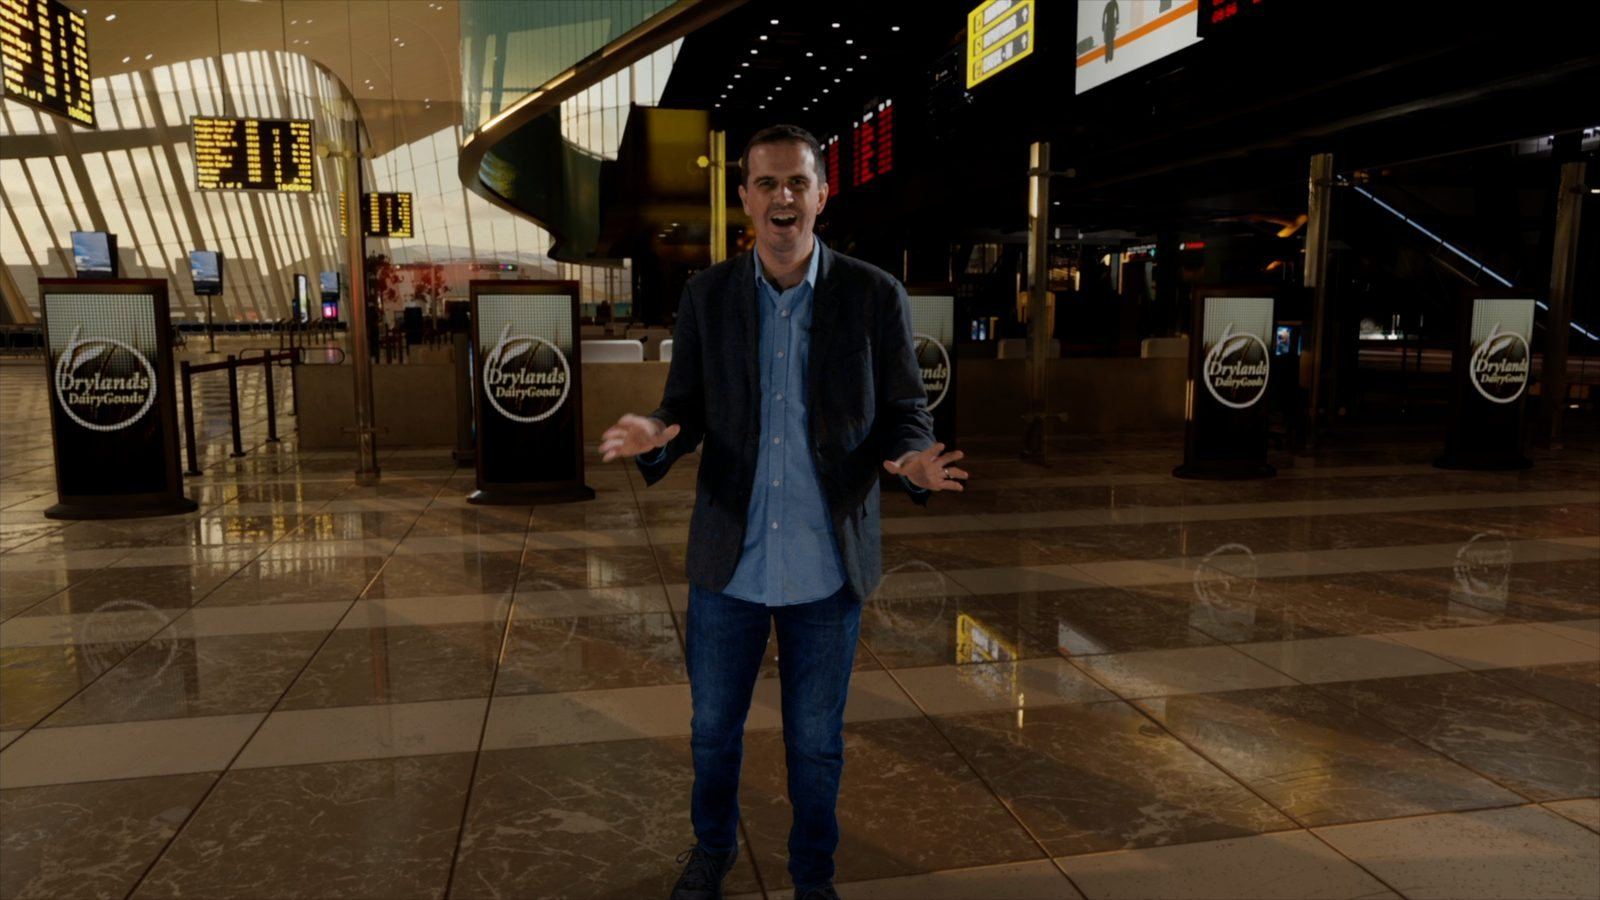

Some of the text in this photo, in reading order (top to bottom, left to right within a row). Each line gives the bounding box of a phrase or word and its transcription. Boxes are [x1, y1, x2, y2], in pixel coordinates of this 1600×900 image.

[488, 367, 565, 390] Drylands
[1209, 360, 1267, 379] Drylands
[61, 371, 149, 394] Drylands
[69, 391, 144, 408] DairyGoods
[496, 385, 561, 401] DairyGoods
